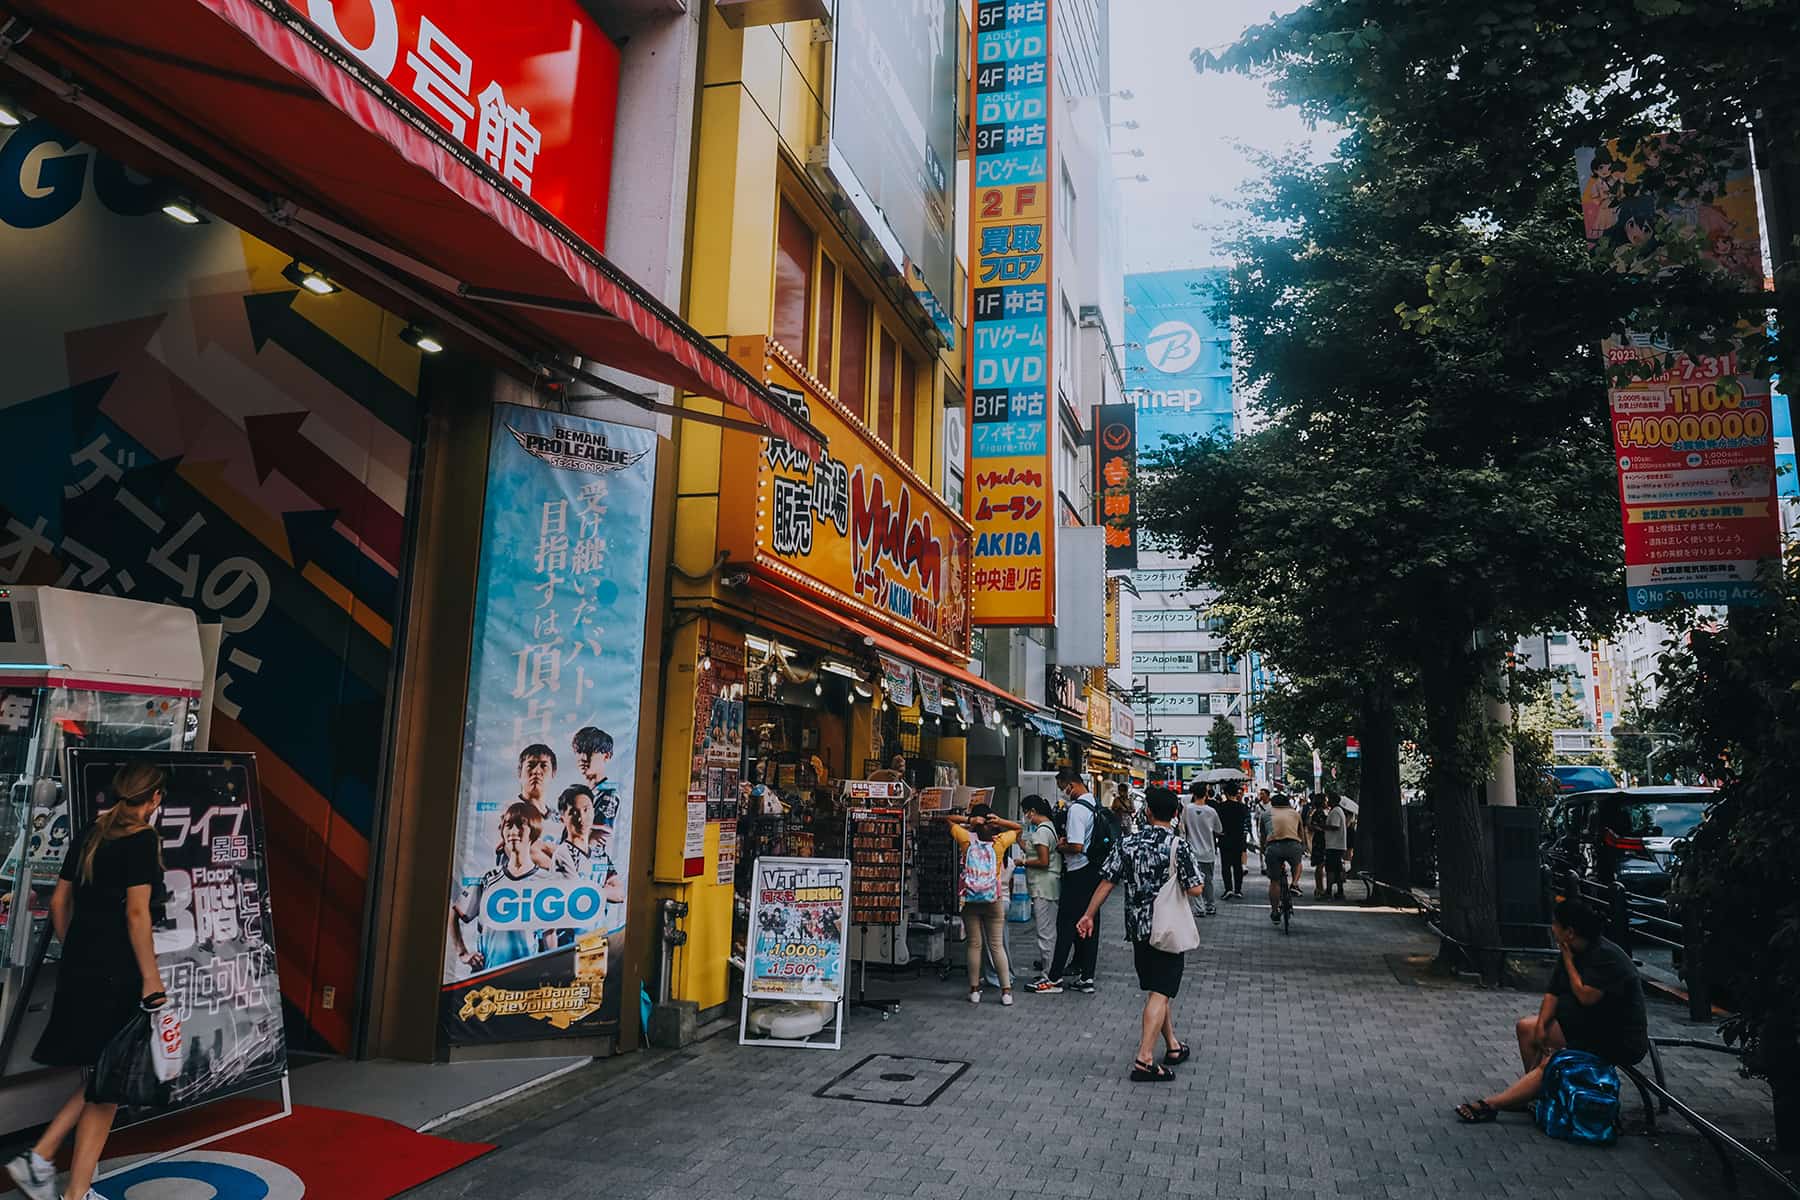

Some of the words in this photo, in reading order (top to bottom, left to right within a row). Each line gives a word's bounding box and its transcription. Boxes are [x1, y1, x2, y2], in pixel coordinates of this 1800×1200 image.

[978, 6, 1004, 27] 5F
[1007, 1, 1046, 25] 中古
[984, 29, 1021, 42] ADULT
[982, 36, 1042, 62] DVD
[978, 67, 1004, 88] 4F
[1007, 61, 1046, 86] 中古
[982, 98, 1042, 122] DVD
[984, 91, 1021, 103] ADULT
[977, 129, 1004, 149] 3F
[1006, 123, 1046, 147] 中古
[977, 156, 1044, 183] PCゲーム
[978, 224, 1042, 256] 買取
[980, 253, 1043, 283] フロア
[977, 293, 1000, 314] 1F
[1005, 289, 1045, 315] 中古
[976, 323, 1044, 350] TVゲーム
[978, 356, 1042, 385] DVD
[974, 395, 1007, 417] B1F
[1011, 391, 1045, 417] 中古
[553, 426, 608, 448] BEMANI
[976, 422, 1041, 443] フィギュア
[526, 434, 563, 456] PRO
[564, 441, 629, 465] LEAGUE
[551, 457, 597, 471] SEASON
[811, 448, 849, 538] 市場
[976, 467, 1042, 493] Mulan
[772, 475, 813, 557] 販売
[975, 495, 1042, 521] ムーラン
[63, 432, 271, 634] ゲームの
[851, 463, 942, 608] Mulan
[975, 531, 1042, 557] AKIBA
[853, 553, 889, 608] ムーラン
[974, 566, 1042, 592] 中央通り店
[1132, 573, 1184, 582] ミングデバイ
[888, 582, 912, 619] AKIBA
[1132, 614, 1193, 622] ミングパソコン
[1132, 655, 1194, 664] コン・Apple製品
[212, 835, 249, 864] 景品
[191, 867, 234, 884] Floor
[763, 868, 843, 890] VTuber
[486, 886, 600, 924] GiGO
[496, 996, 587, 1014] Revolution
